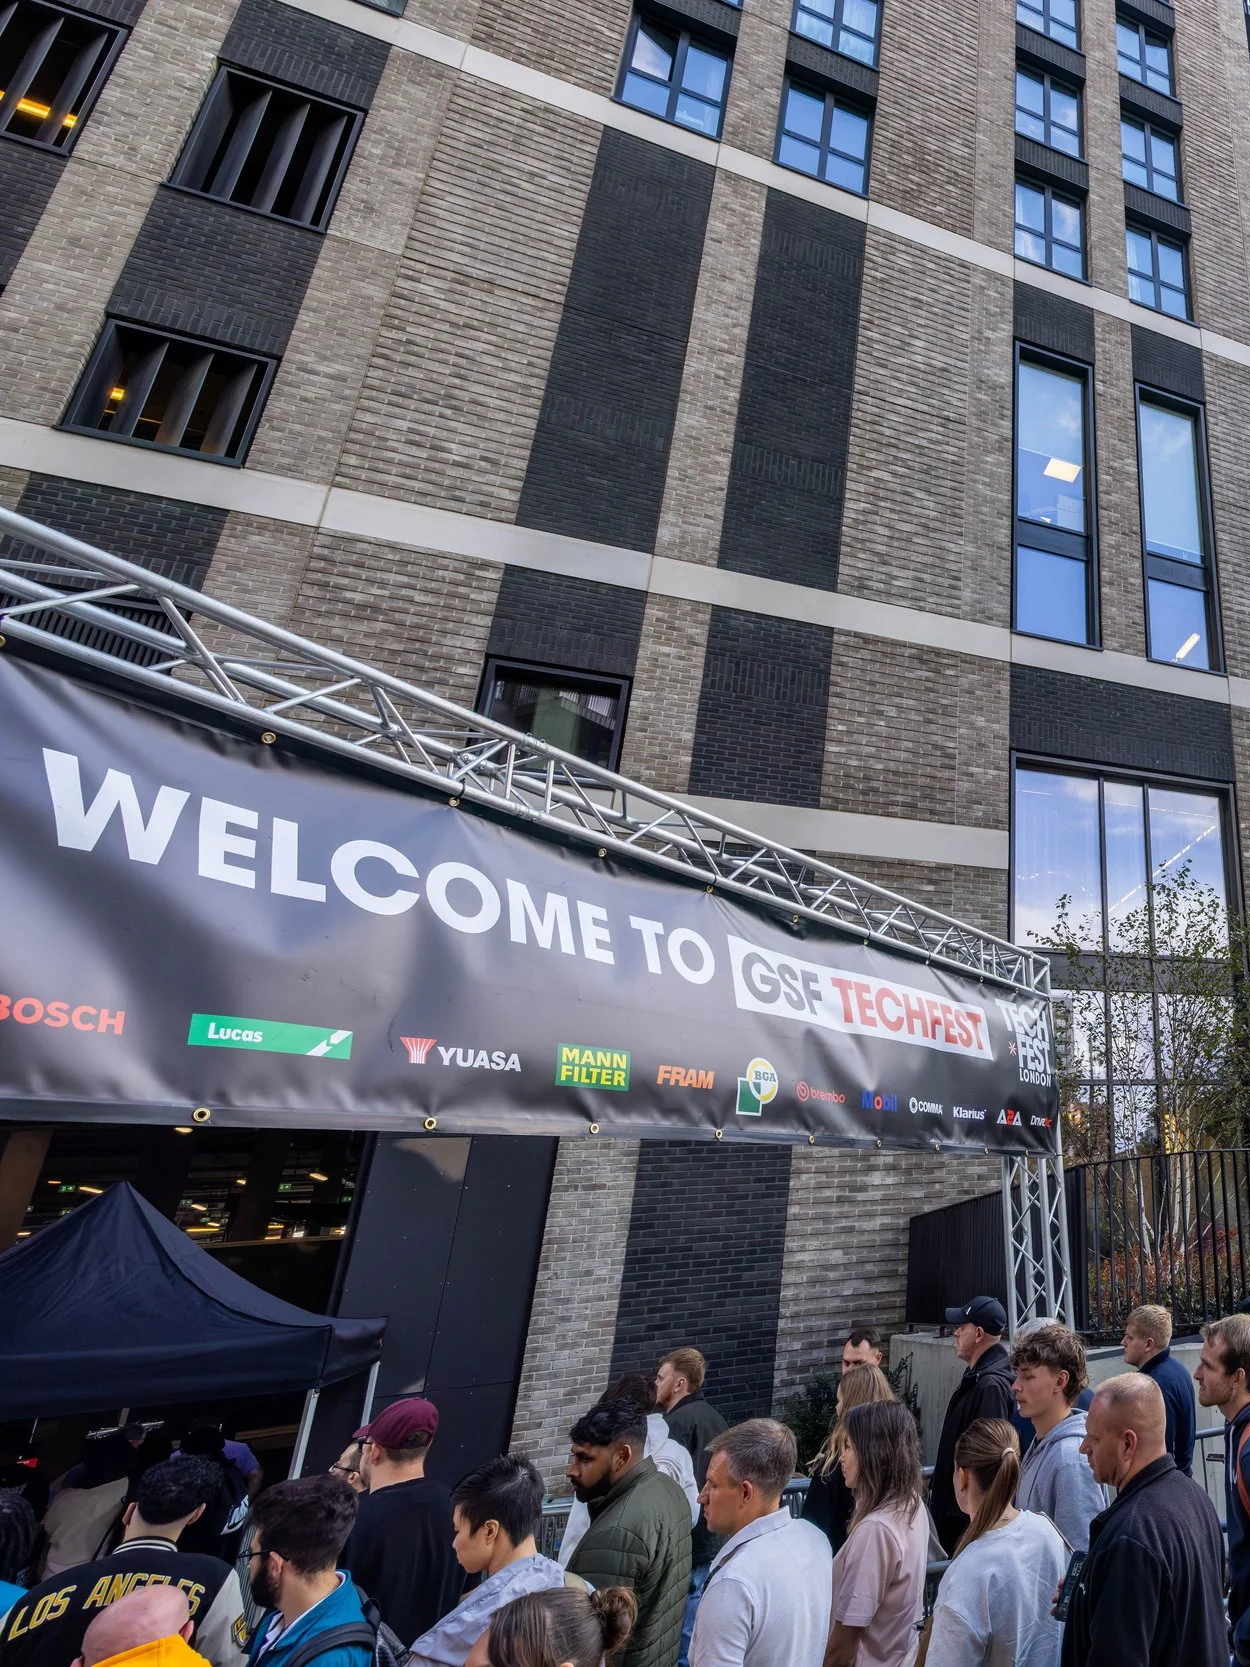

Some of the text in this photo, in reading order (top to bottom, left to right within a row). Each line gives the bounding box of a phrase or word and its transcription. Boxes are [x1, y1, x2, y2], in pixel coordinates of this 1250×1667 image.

[43, 748, 983, 1050] WELCOME TO GSF TECHFEST
[995, 998, 1049, 1042] TECH
[208, 1022, 263, 1043] Lucas
[437, 1046, 522, 1072] YUASA
[562, 1047, 627, 1069] MANN
[1016, 1032, 1051, 1074] FEST
[560, 1065, 626, 1086] FILTER
[656, 1065, 715, 1089] FRAM
[754, 1071, 776, 1082] BGA
[1020, 1067, 1052, 1087] LONDON
[810, 1087, 846, 1103] brembo
[861, 1090, 898, 1112] Mobil
[918, 1101, 943, 1114] COMMA
[953, 1106, 985, 1120] Klarius
[996, 1109, 1022, 1126] A2A
[8, 1584, 77, 1642] LOS
